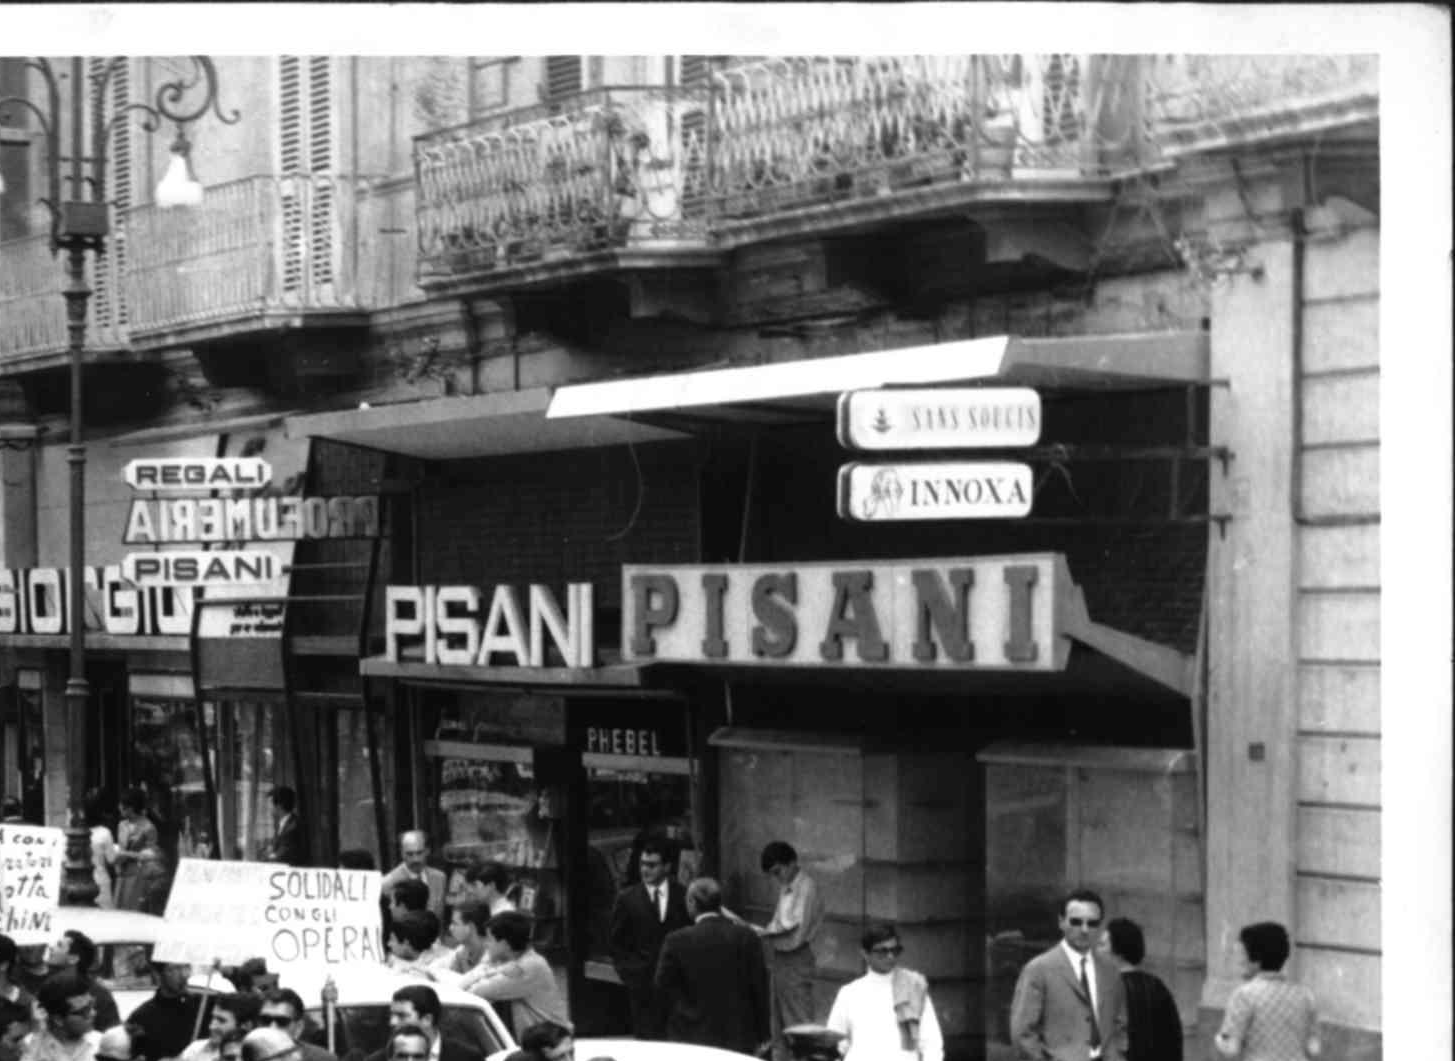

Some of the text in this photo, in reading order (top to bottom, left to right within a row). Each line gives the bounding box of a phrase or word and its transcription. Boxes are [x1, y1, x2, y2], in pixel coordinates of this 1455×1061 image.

[136, 464, 264, 485] REGALI
[911, 477, 1027, 506] INNOXA
[135, 557, 272, 581] PISANI
[385, 582, 592, 669] PISANI
[631, 565, 1039, 663] PISANI
[587, 727, 660, 756] PHEBEL
[269, 869, 367, 902] SOLIDALI
[265, 905, 305, 923] CON
[311, 908, 336, 923] GLI
